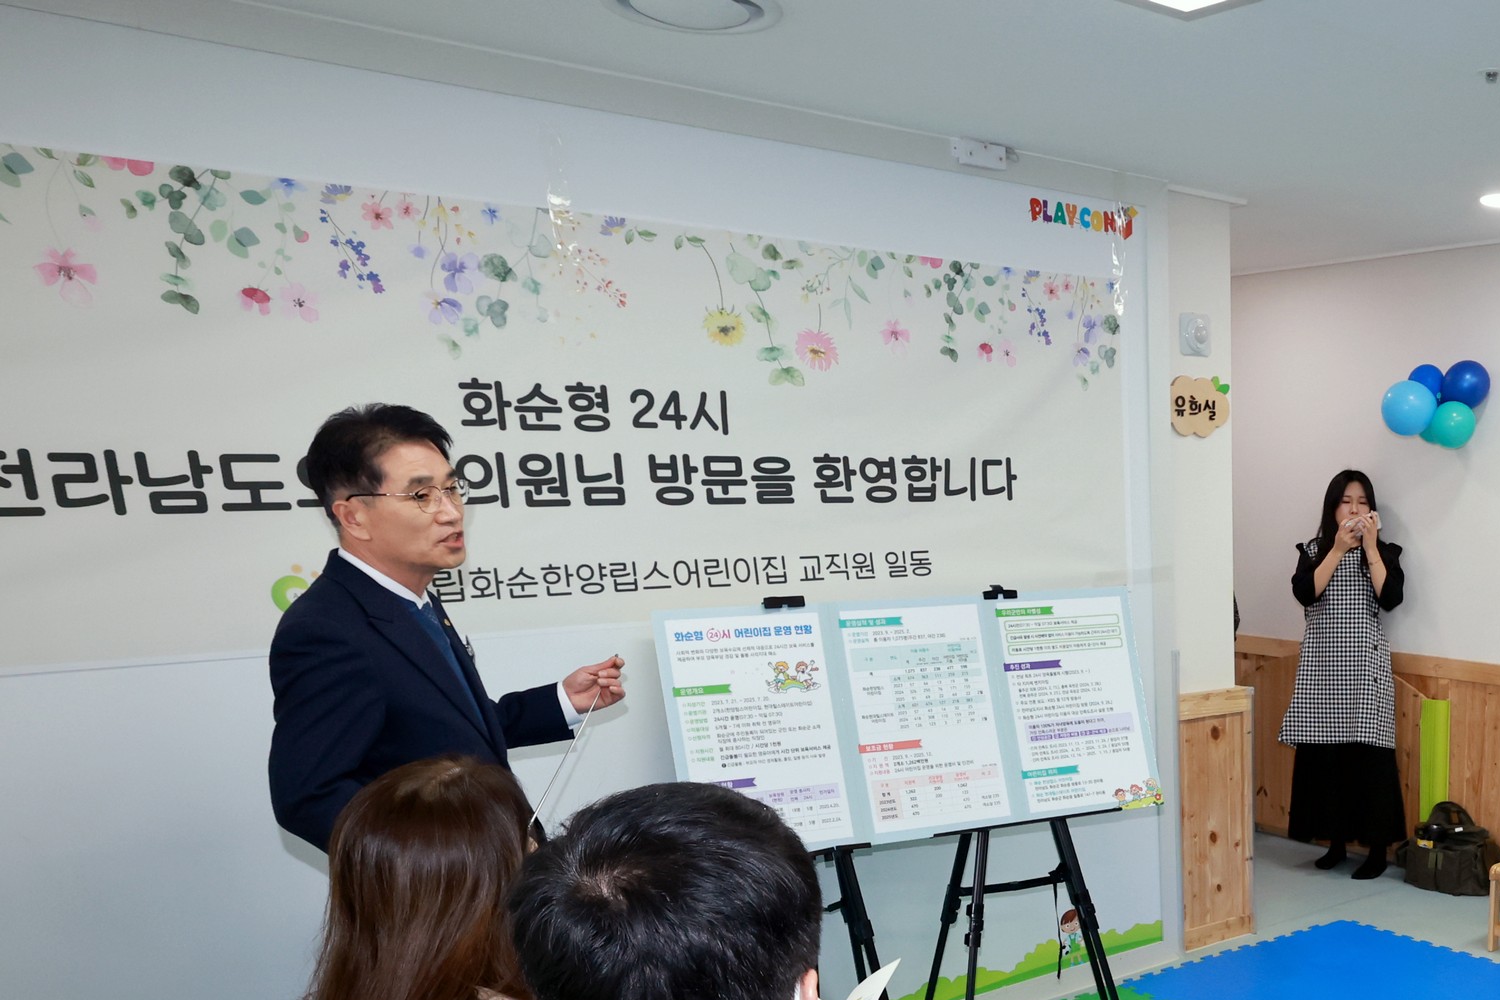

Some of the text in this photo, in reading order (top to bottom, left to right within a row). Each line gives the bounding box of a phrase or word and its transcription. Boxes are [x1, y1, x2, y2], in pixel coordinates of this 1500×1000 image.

[458, 378, 731, 436] 화순형 24시
[1174, 395, 1217, 421] 유희실
[0, 448, 1017, 517] 라남도 의원님 방문을 환영합니다
[799, 551, 877, 583] 교직원
[884, 549, 933, 579] 일동
[673, 624, 812, 641] 화순형 24시 어린이집 운영 현황
[679, 686, 704, 695] 운영개요
